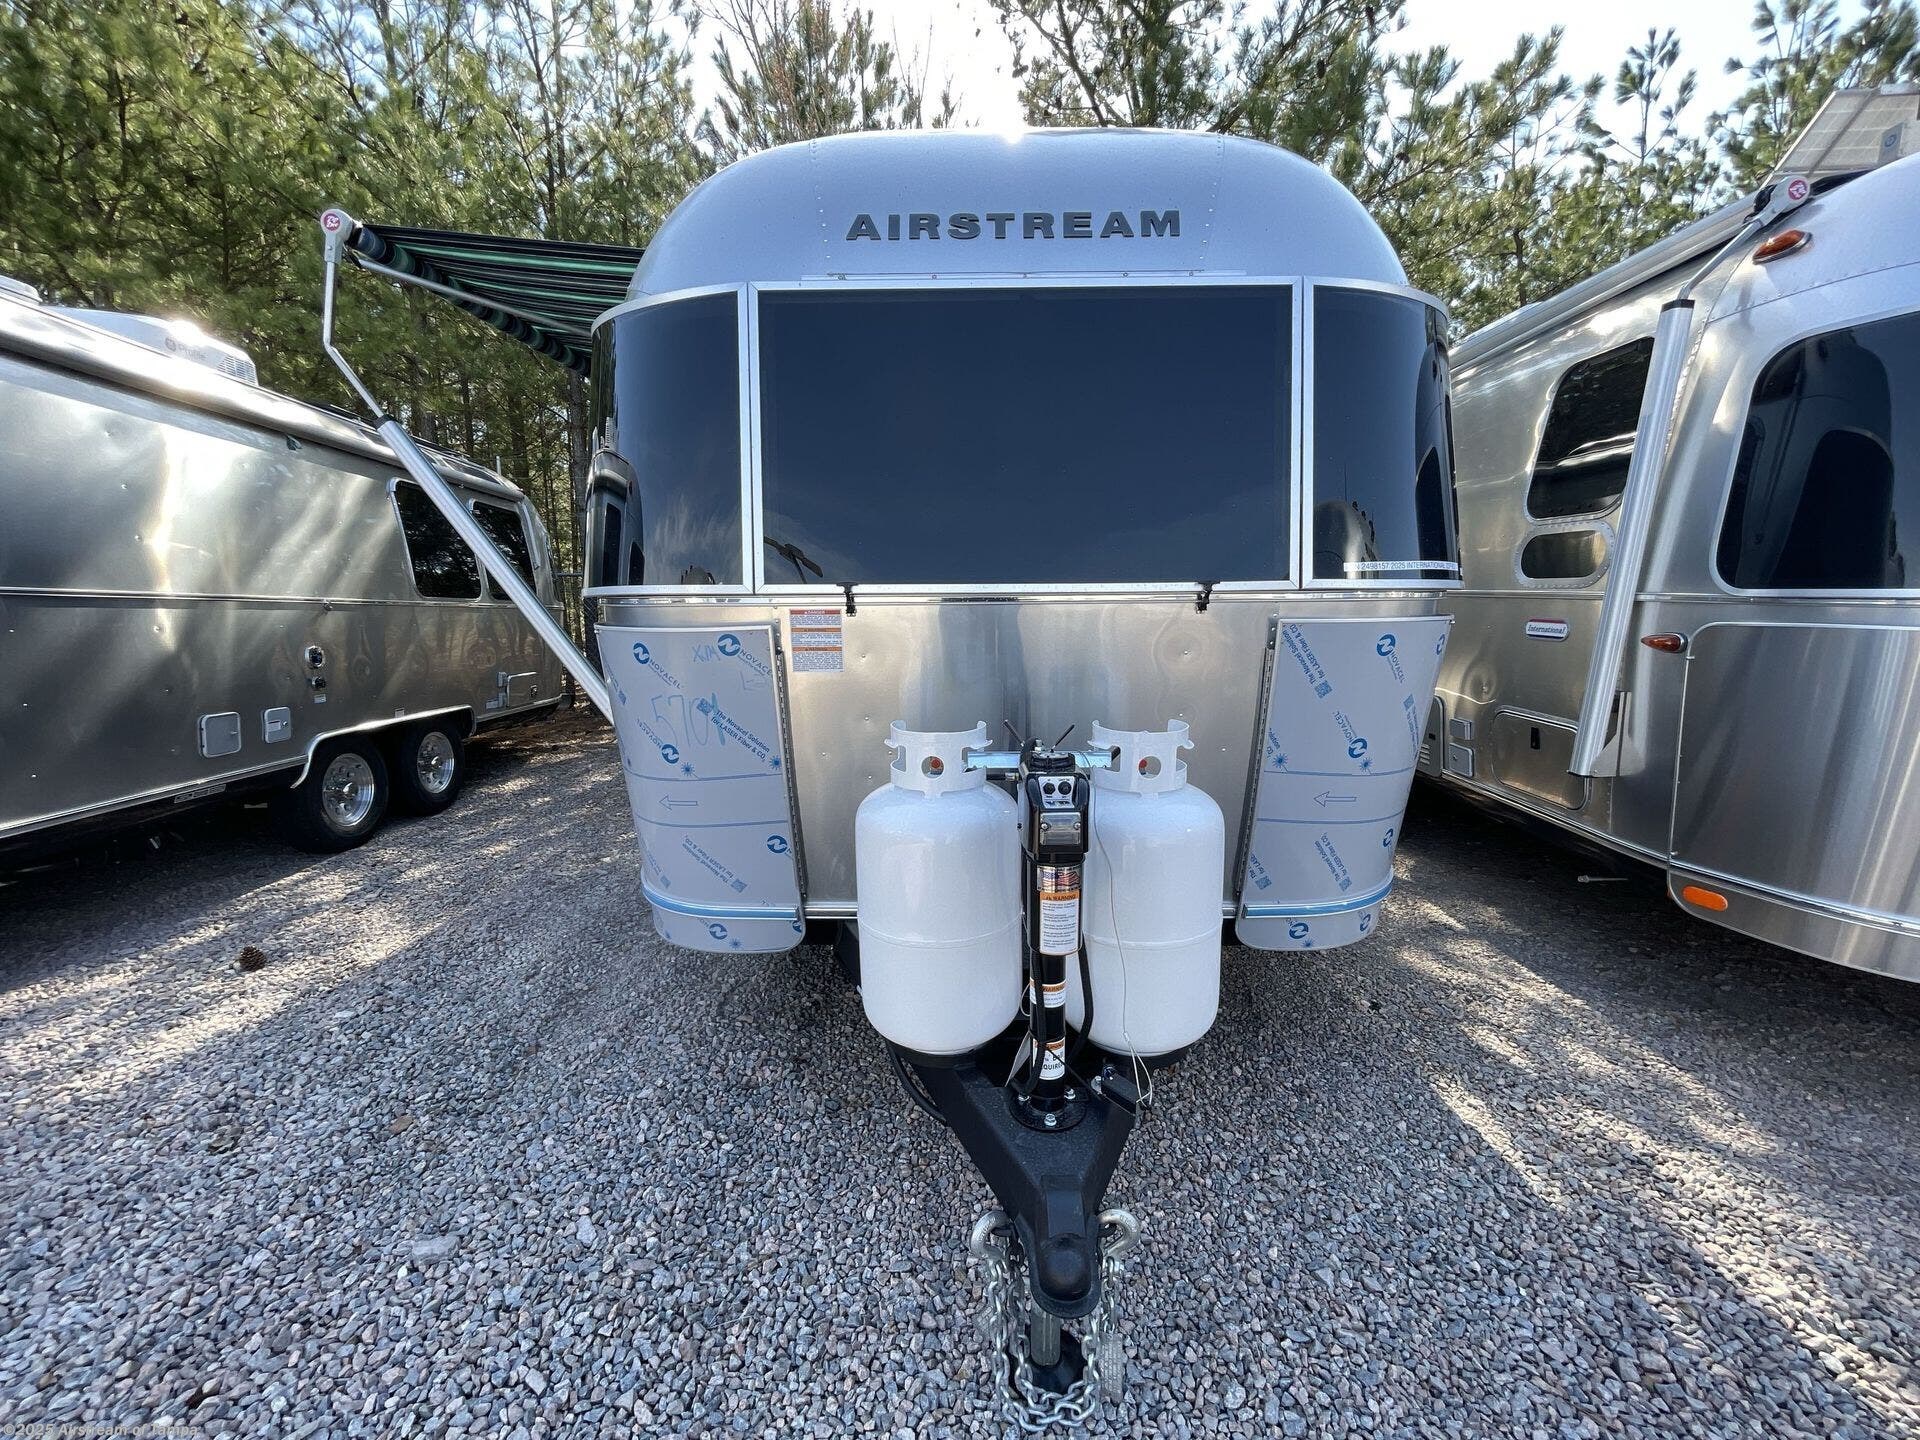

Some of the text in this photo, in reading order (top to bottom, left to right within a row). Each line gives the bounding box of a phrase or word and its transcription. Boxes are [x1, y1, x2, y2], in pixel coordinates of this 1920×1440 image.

[846, 210, 1180, 240] AIRSTREAM
[1528, 624, 1566, 634] International
[1282, 629, 1317, 684] The Novacel Solution
[1297, 637, 1311, 653] Fiber
[649, 659, 681, 689] NOVACEL
[1306, 652, 1321, 670] LASER
[1316, 669, 1326, 679] for
[1391, 650, 1405, 683] NOVACEL
[636, 718, 661, 748] NOVACEL
[710, 716, 720, 726] for
[719, 723, 738, 739] LASER
[737, 736, 753, 749] Fiber
[716, 710, 771, 753] The Novacel Solution
[1335, 711, 1355, 741] NOVACEL
